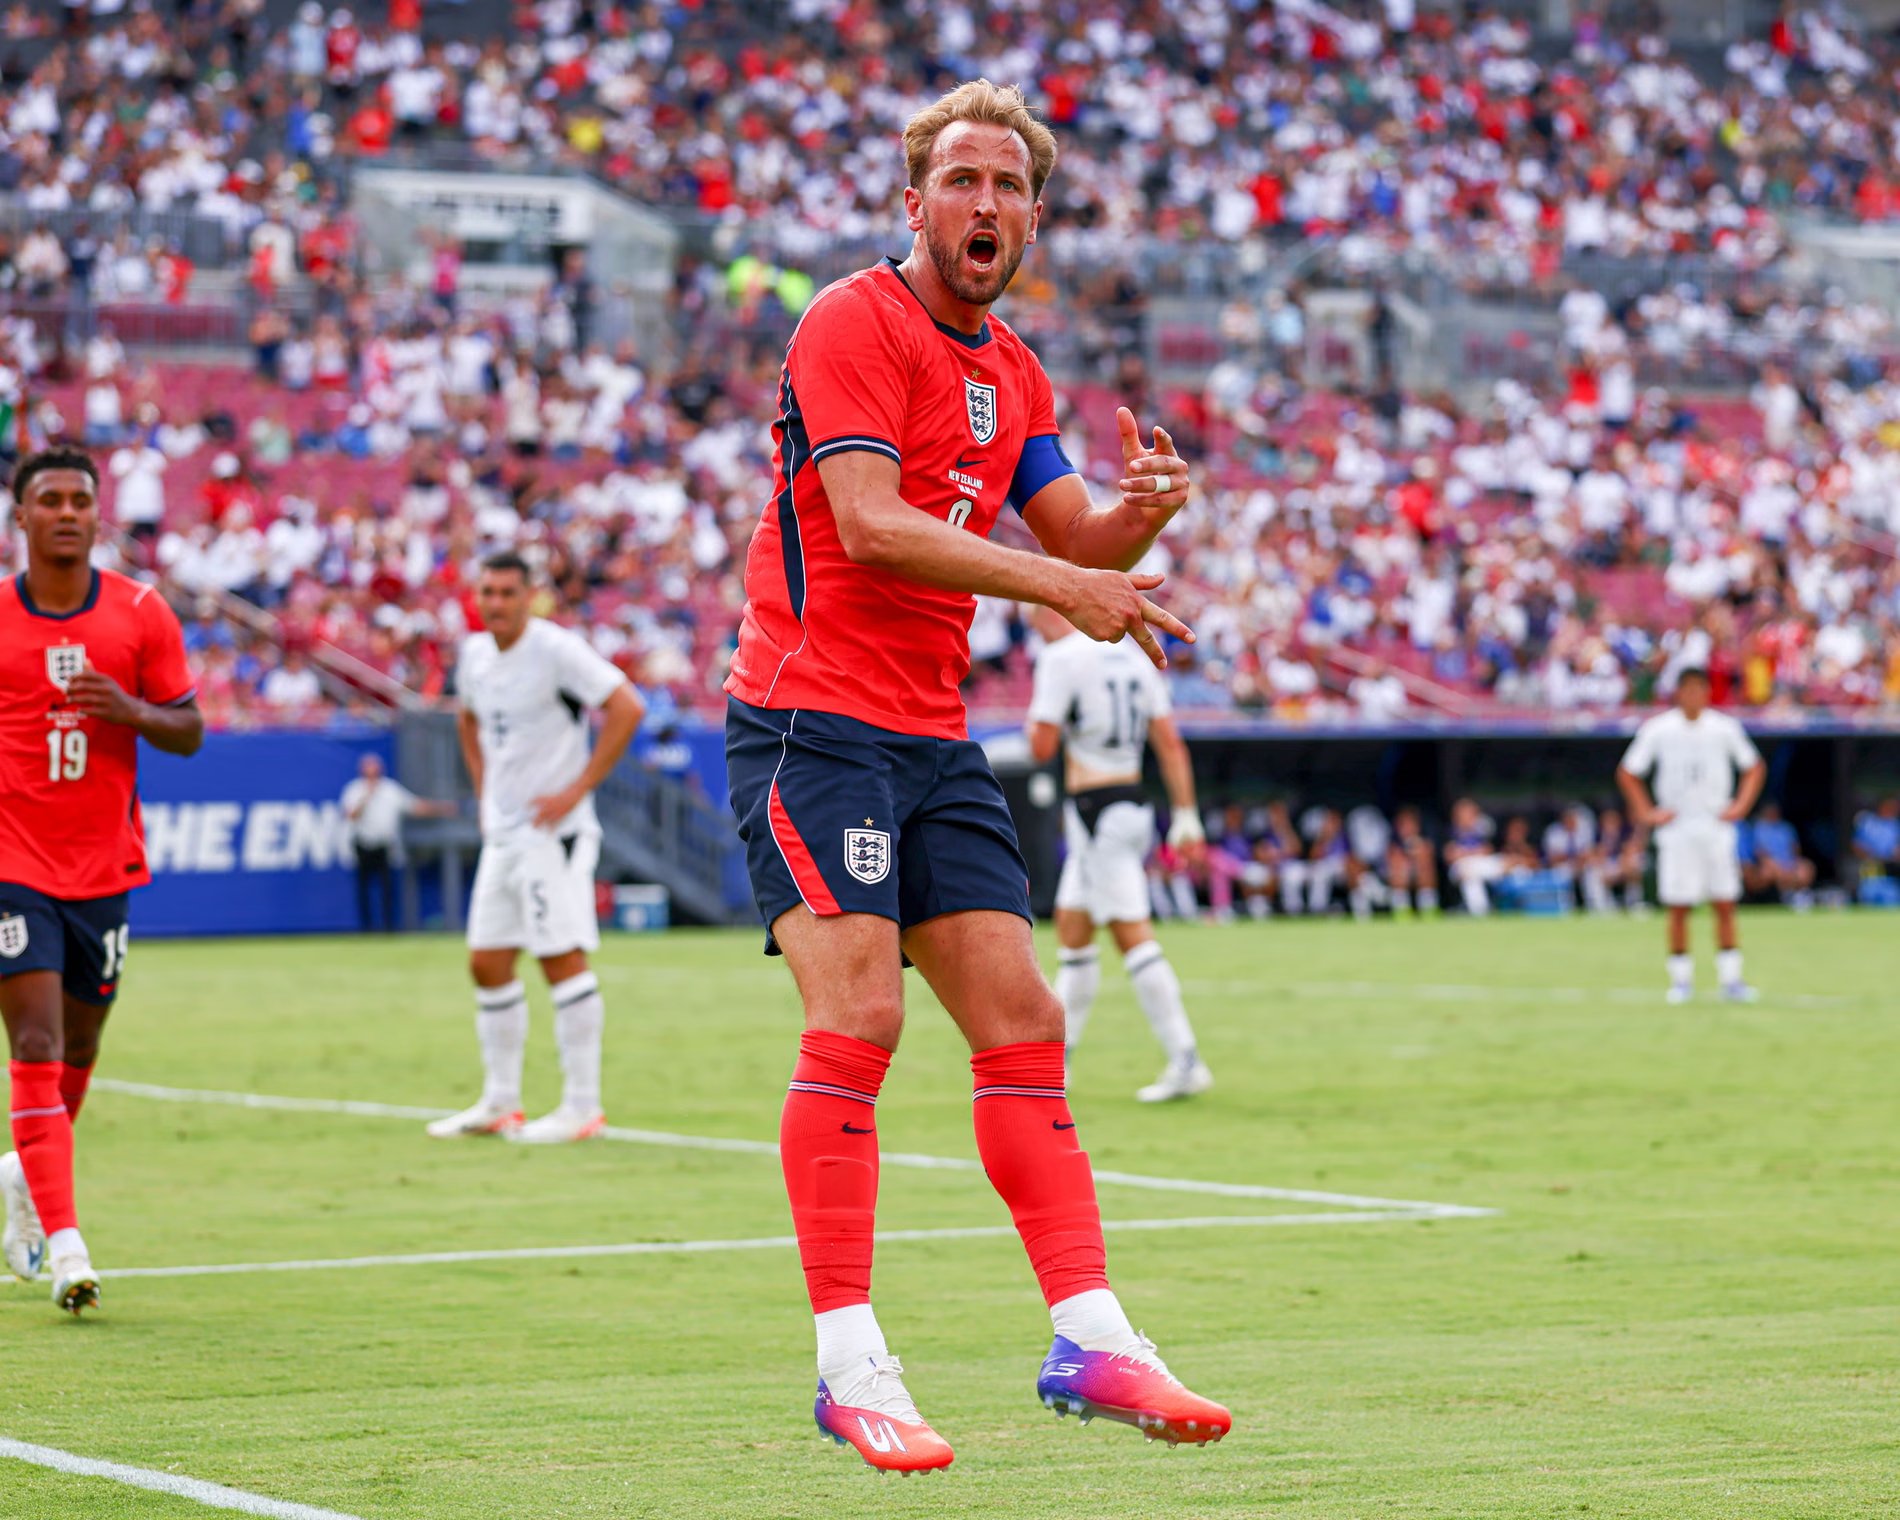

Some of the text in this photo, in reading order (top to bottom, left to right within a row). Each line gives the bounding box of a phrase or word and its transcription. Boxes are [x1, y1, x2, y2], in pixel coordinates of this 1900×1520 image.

[948, 469, 983, 490] NEW ZEALAND
[46, 729, 88, 782] 19
[242, 801, 356, 871] EN
